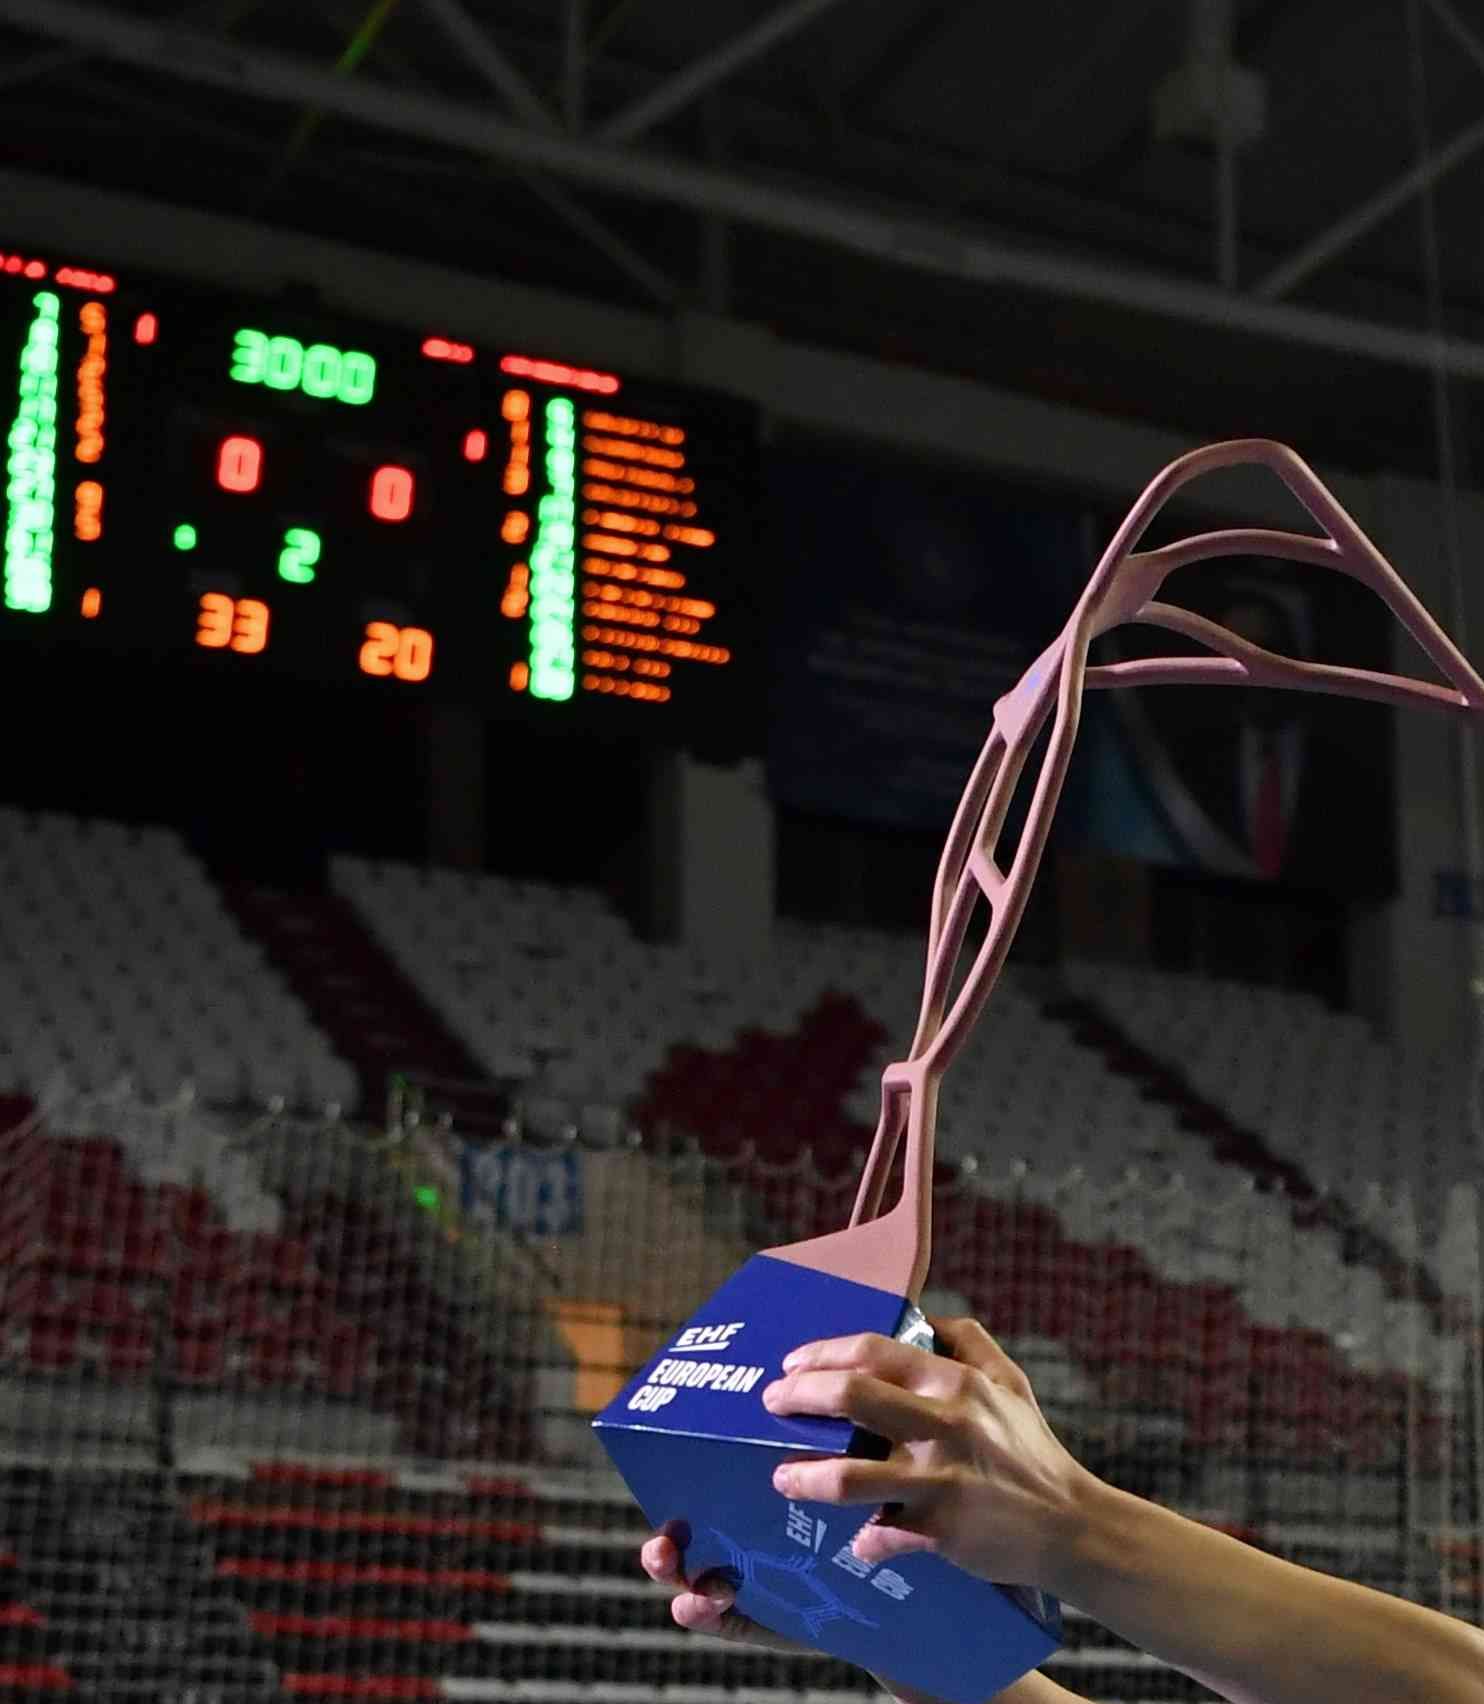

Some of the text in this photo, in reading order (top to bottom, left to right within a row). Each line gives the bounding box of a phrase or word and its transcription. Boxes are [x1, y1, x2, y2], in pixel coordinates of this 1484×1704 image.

[217, 435, 262, 493] 0
[369, 466, 414, 522] 0
[278, 527, 321, 584] 2
[195, 592, 270, 654] 33
[359, 621, 433, 682] 20
[674, 1322, 746, 1348] EHF
[626, 1384, 678, 1413] CUP
[646, 1357, 766, 1393] EUROPEAN
